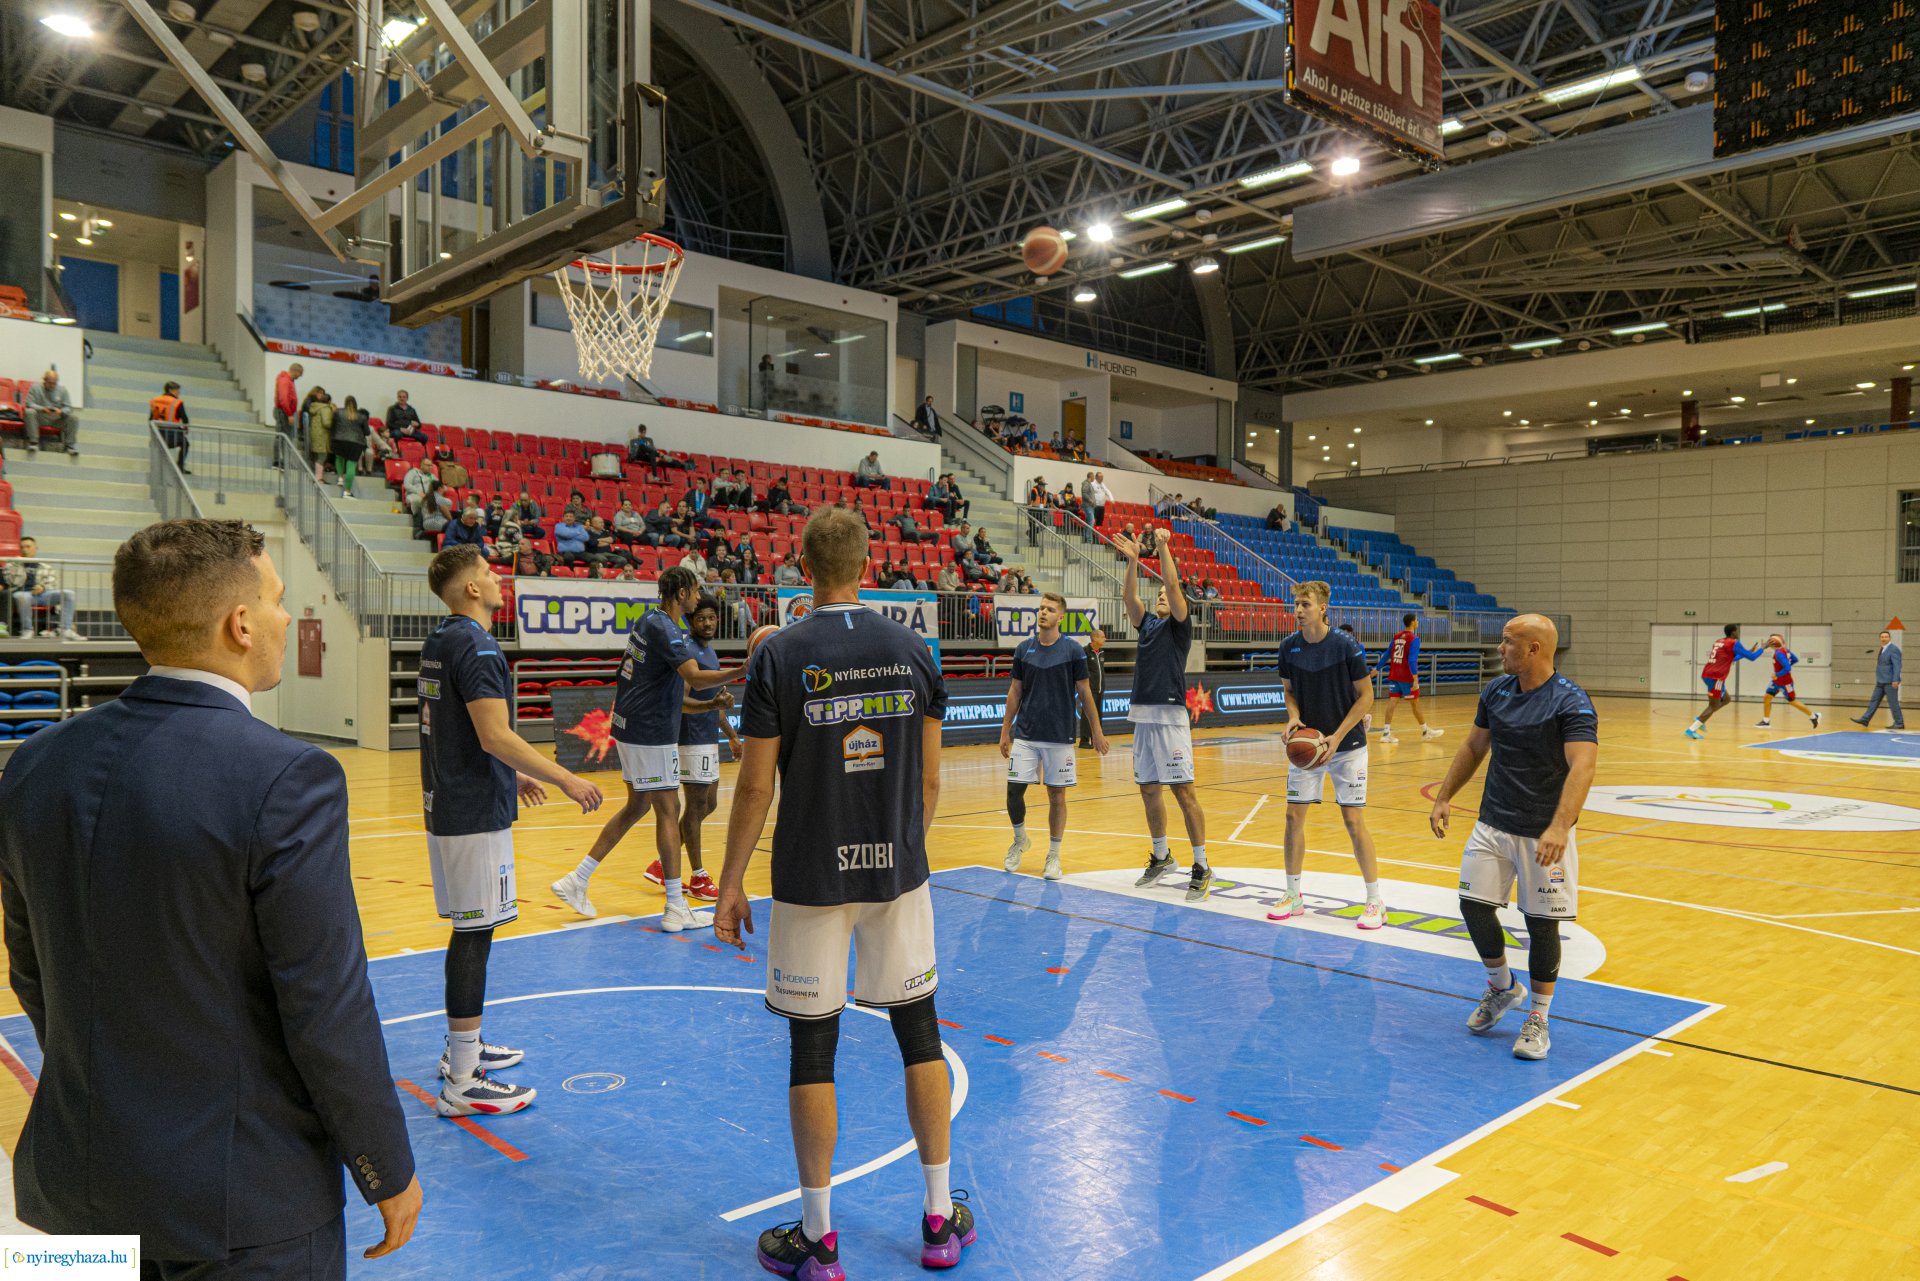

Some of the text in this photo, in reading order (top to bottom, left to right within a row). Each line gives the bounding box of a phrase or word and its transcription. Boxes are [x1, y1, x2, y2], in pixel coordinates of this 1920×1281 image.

[1303, 67, 1420, 138] Ahol a pénze többet ér!
[1100, 359, 1137, 377] HÜBNER
[834, 663, 913, 682] NYÍREGYHÁZA
[848, 738, 878, 751] újház
[673, 758, 678, 774] 2
[702, 756, 709, 771] 0
[837, 842, 894, 872] SZOBI
[500, 875, 508, 902] 11
